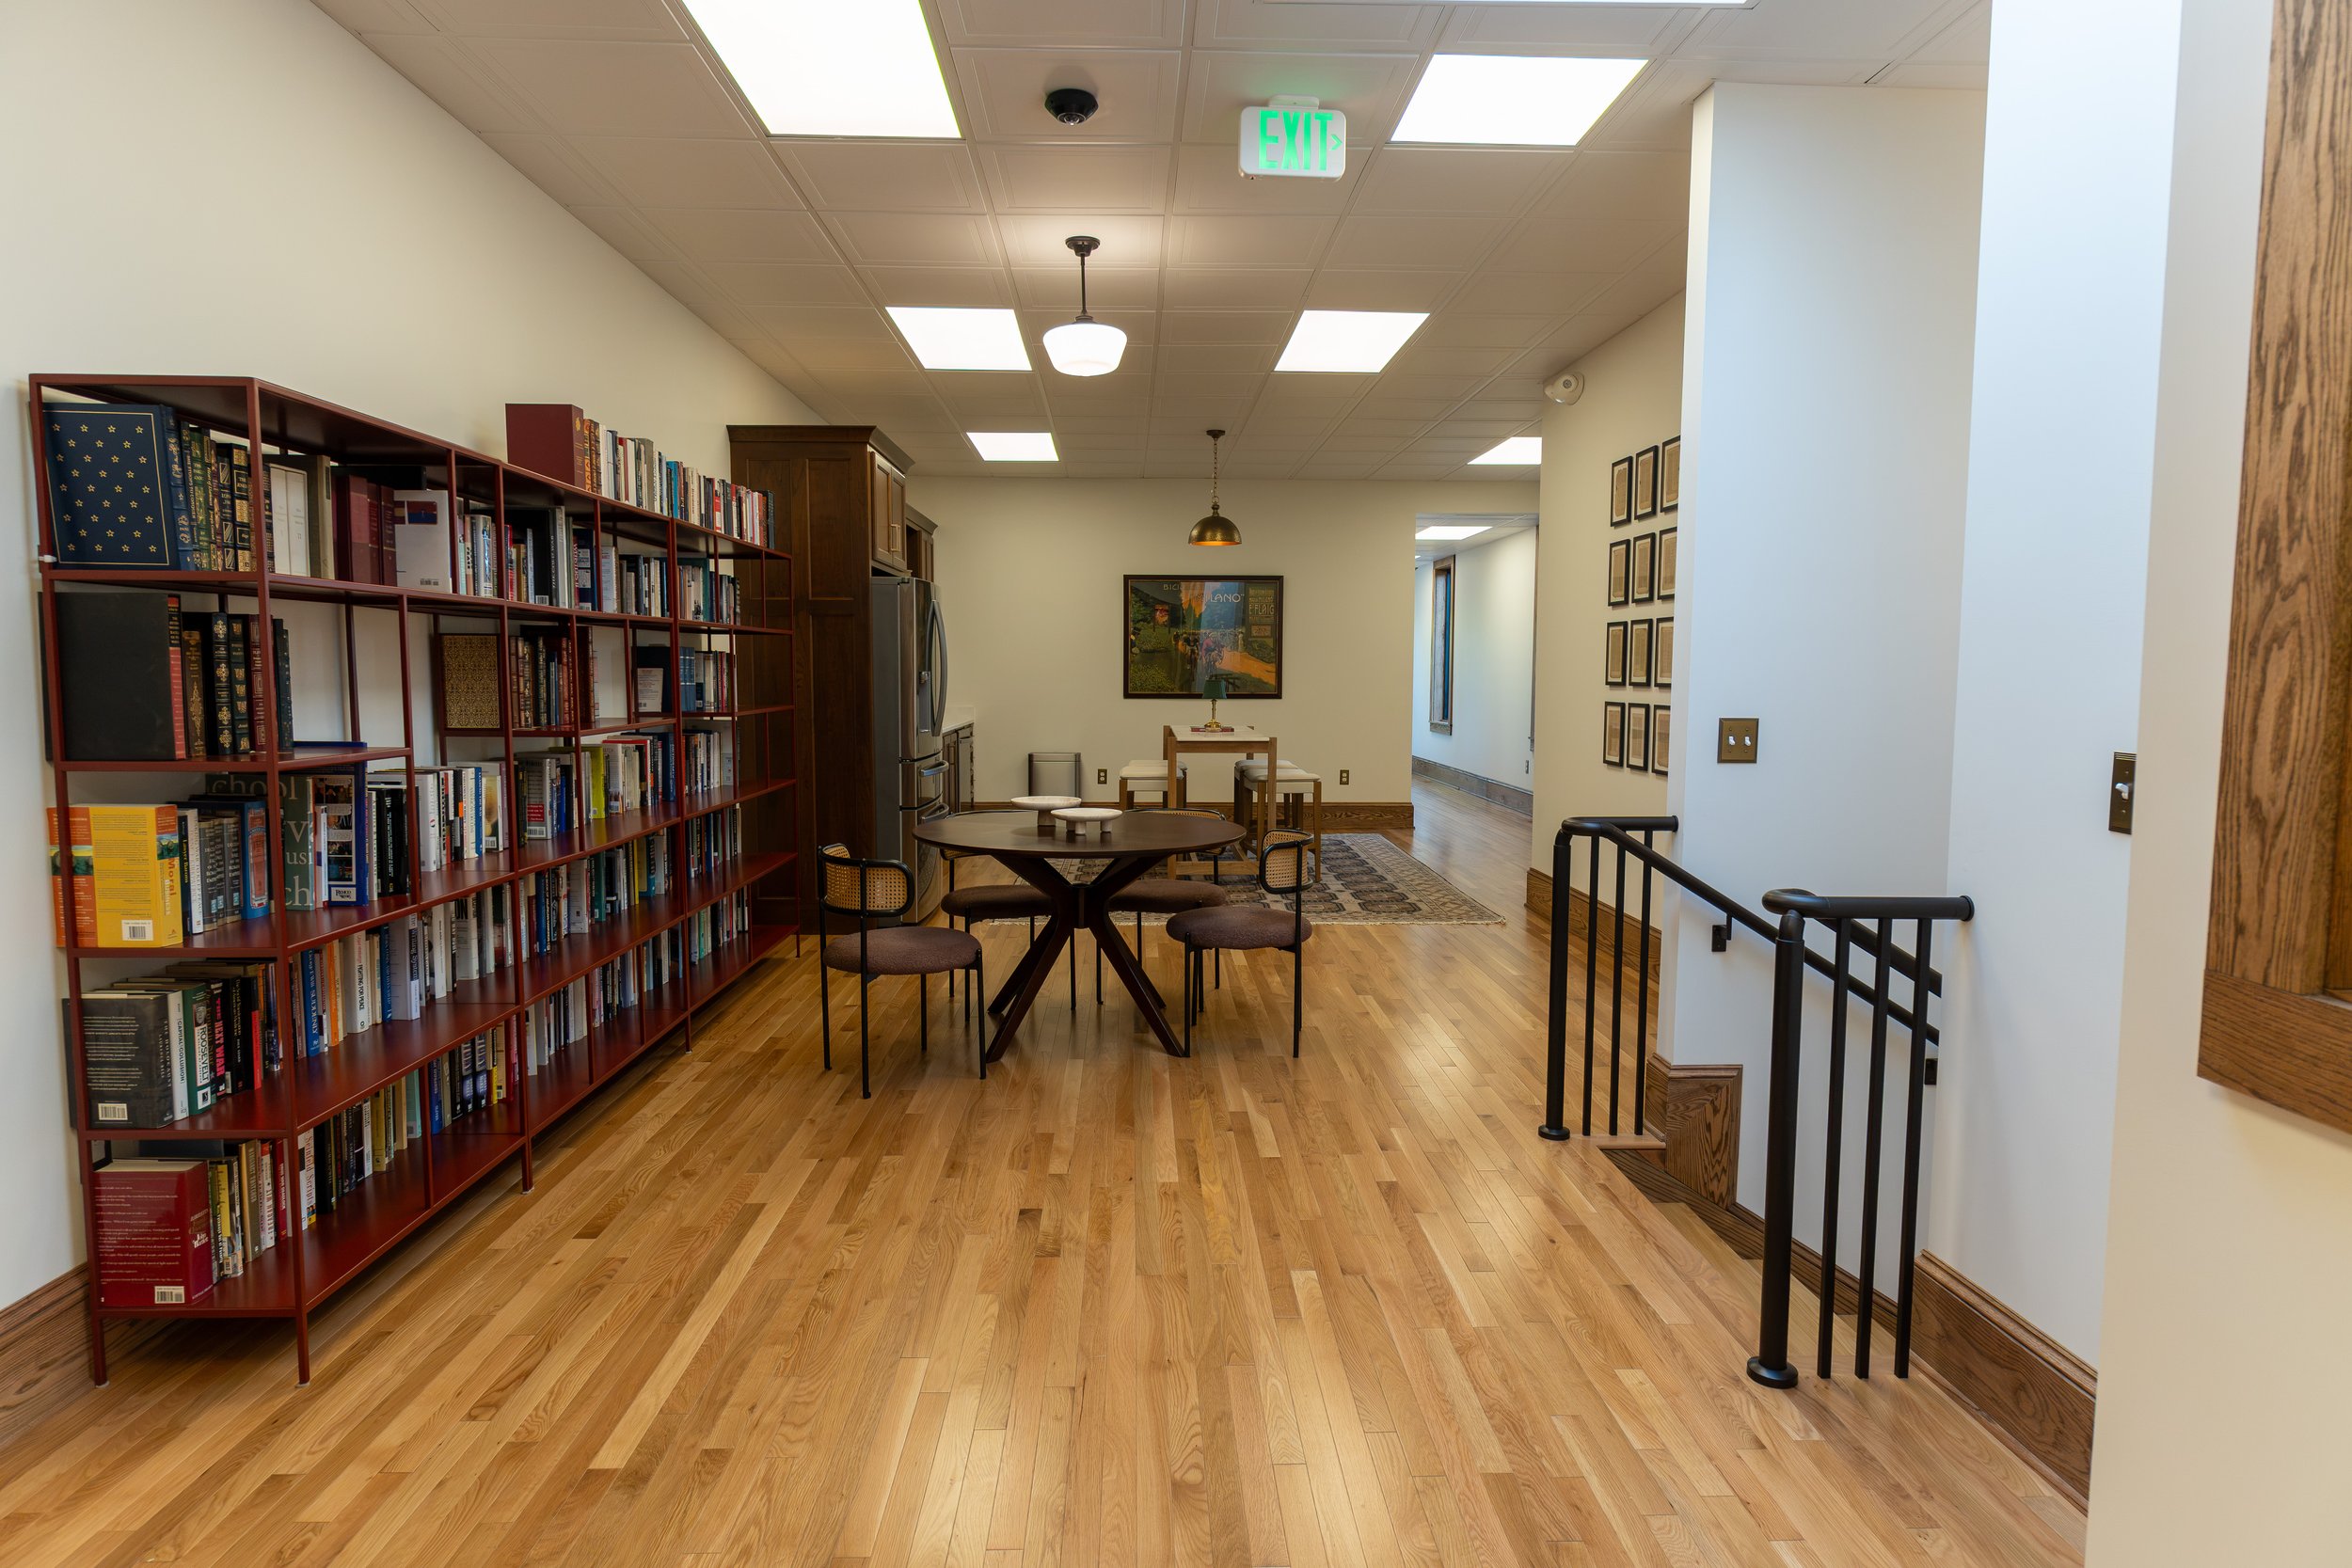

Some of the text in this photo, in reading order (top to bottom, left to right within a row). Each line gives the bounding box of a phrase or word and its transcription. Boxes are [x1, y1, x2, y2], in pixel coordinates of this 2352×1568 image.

[1259, 110, 1333, 170] EXIT
[167, 858, 177, 895] Moral
[199, 1026, 210, 1081] ROOSEVELT
[215, 1021, 224, 1045] NEXT
[164, 1038, 172, 1087] HOLOCAUST
[215, 1045, 225, 1077] WAR
[305, 1135, 314, 1205] Seinfeld Scripts
